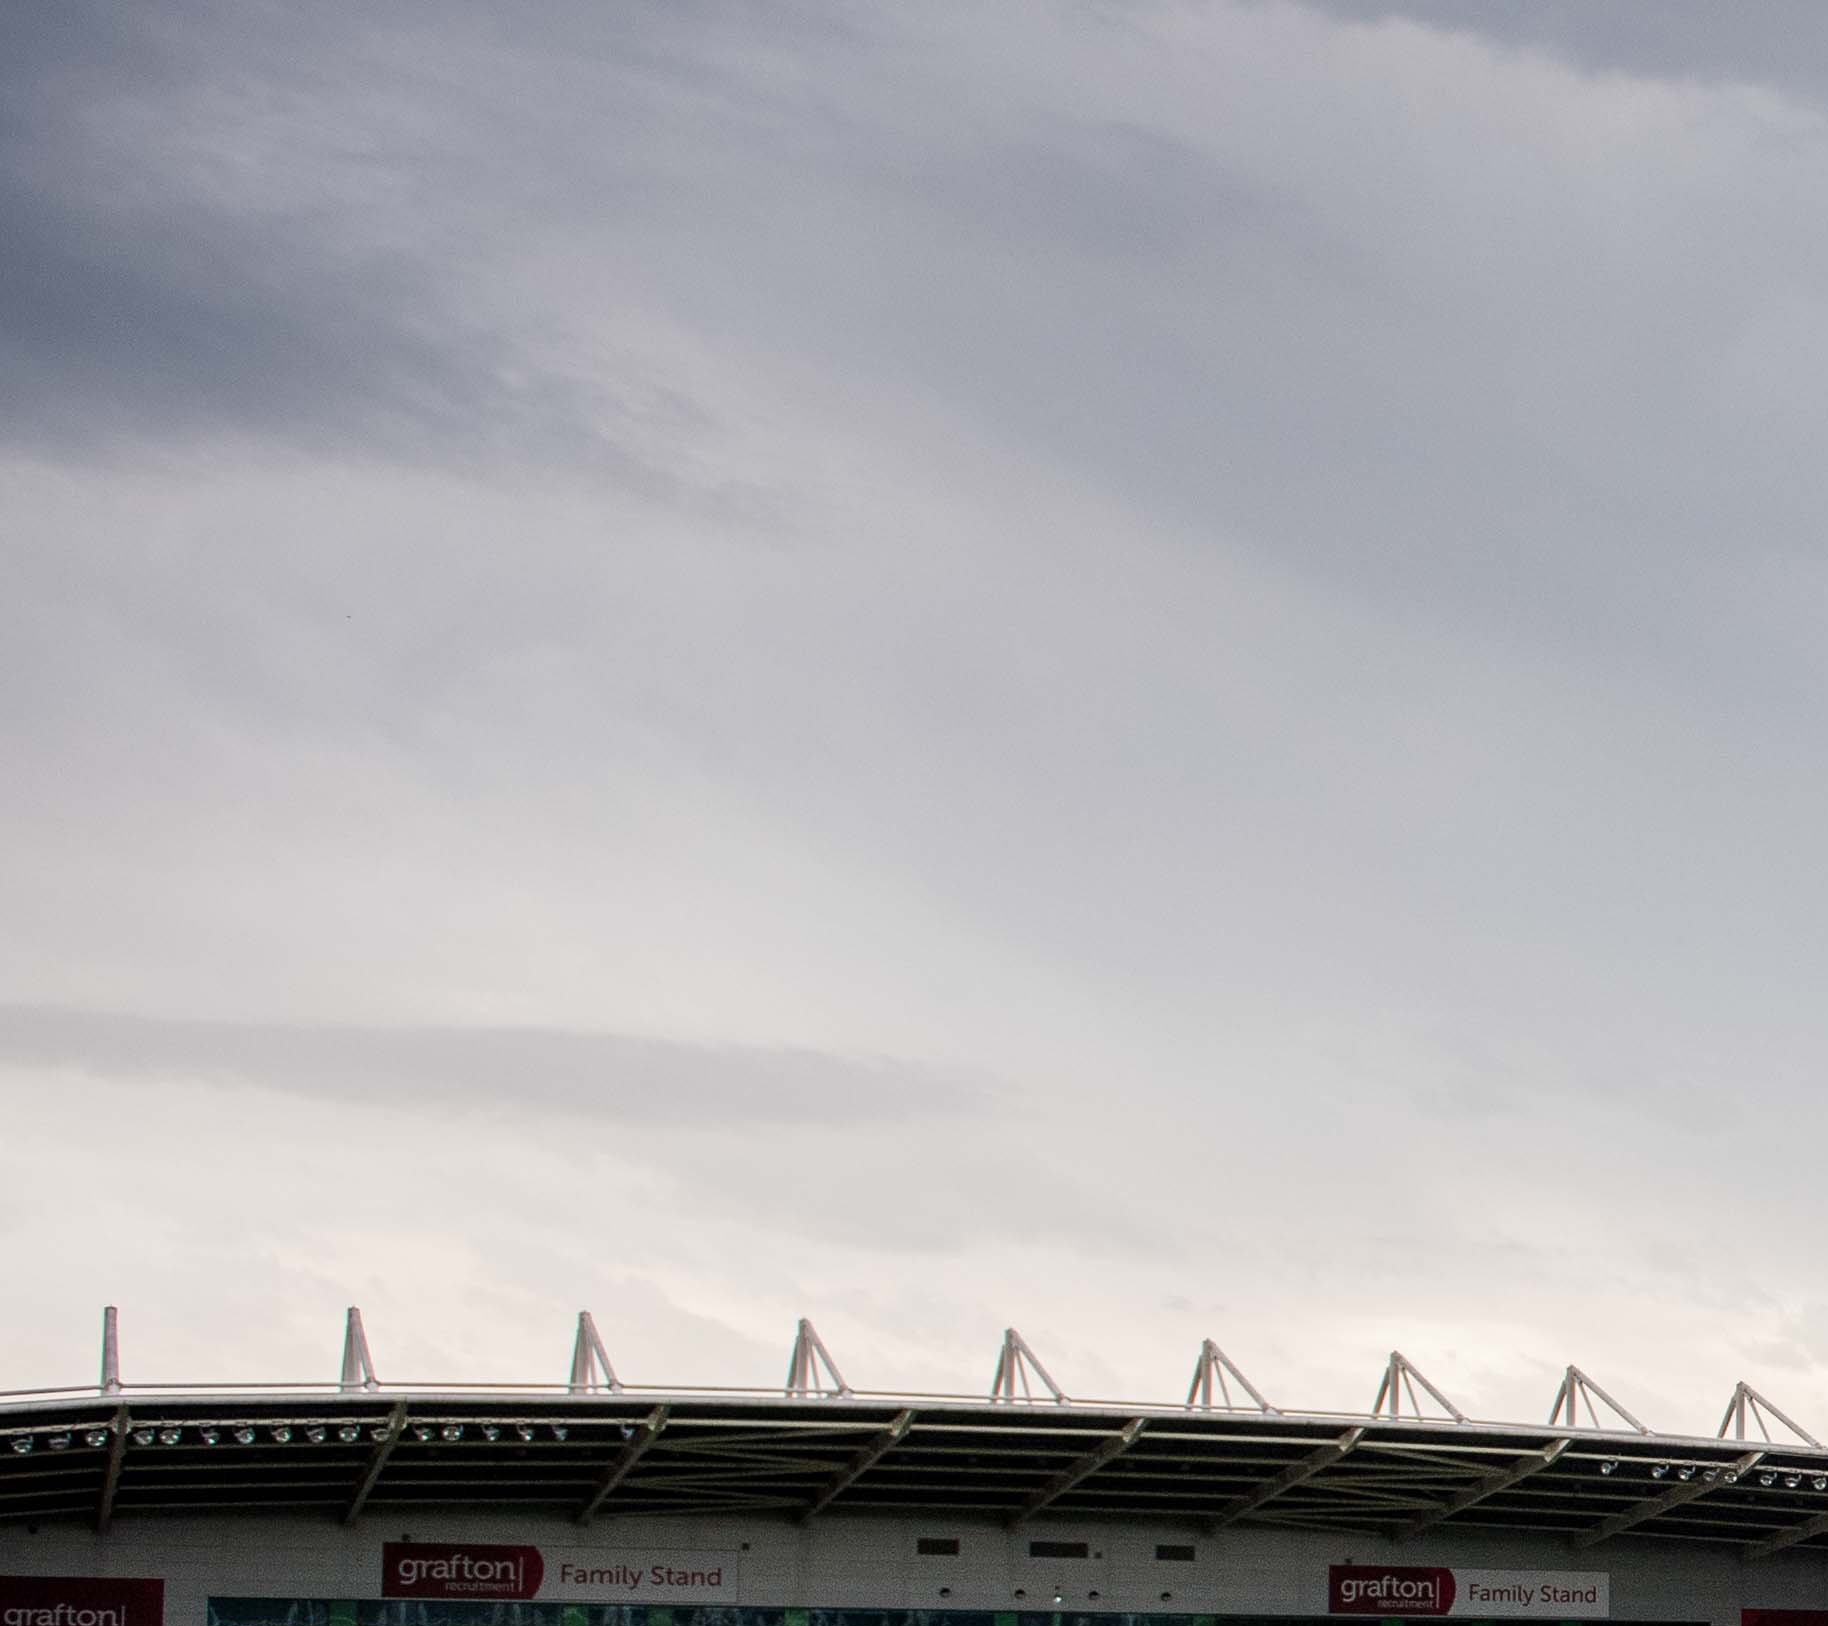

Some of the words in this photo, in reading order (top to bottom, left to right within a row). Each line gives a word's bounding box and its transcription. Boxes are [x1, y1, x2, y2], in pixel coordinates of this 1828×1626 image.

[399, 1553, 516, 1585] grafton
[560, 1563, 642, 1589] Family
[651, 1565, 722, 1586] Stand
[445, 1581, 516, 1592] recruitment
[1341, 1575, 1434, 1602] grafton
[1469, 1583, 1534, 1606] Family
[1540, 1585, 1597, 1603] Stand
[1377, 1599, 1434, 1609] recruitment
